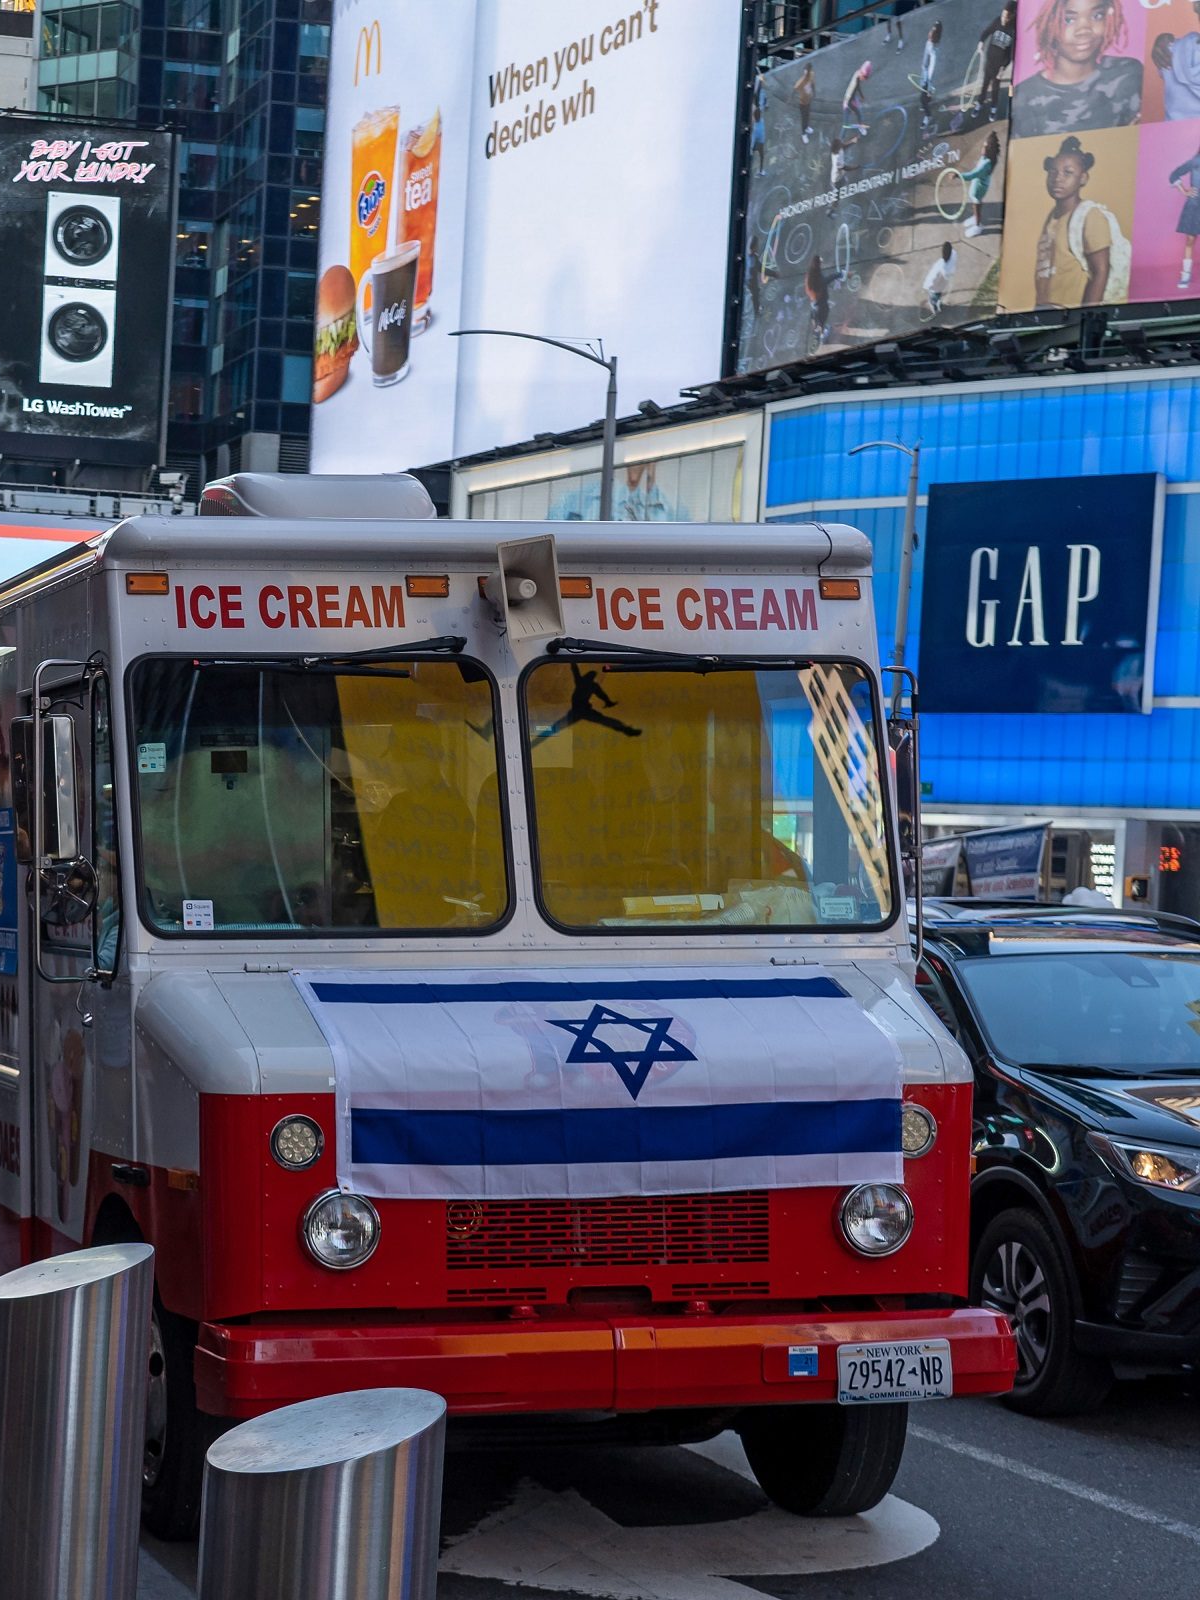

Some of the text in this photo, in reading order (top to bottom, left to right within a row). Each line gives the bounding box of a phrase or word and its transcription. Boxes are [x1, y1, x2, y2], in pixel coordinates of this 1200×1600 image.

[488, 0, 659, 108] When you can't
[485, 79, 596, 160] decide wh
[29, 139, 82, 160] BABY
[91, 141, 150, 161] GOT
[12, 160, 156, 184] YOUR LAUNDRY
[410, 162, 434, 182] sweet
[813, 188, 840, 208] RIDGE
[839, 170, 895, 200] ELEMENTARY
[947, 149, 961, 163] TN
[357, 179, 386, 223] Fanta
[405, 178, 433, 211] tea
[22, 398, 44, 413] LG
[175, 585, 406, 629] ICE CREAM
[597, 588, 819, 631] ICE CREAM
[964, 543, 1102, 649] GAP
[193, 903, 210, 911] Square
[866, 1345, 922, 1358] NEW YORK
[848, 1356, 943, 1391] 29542 NB
[869, 1390, 922, 1399] COMMERCIAL
